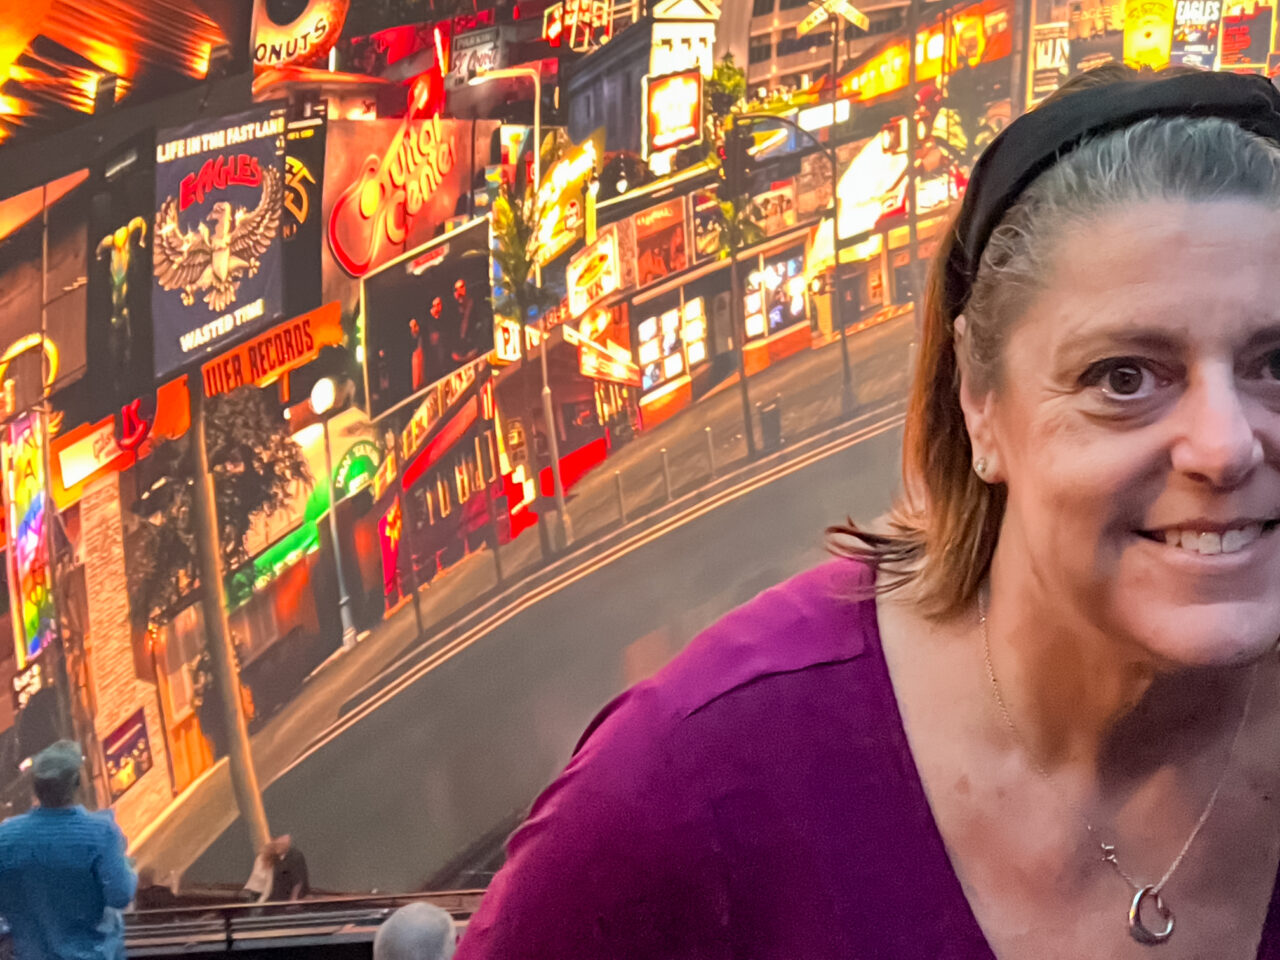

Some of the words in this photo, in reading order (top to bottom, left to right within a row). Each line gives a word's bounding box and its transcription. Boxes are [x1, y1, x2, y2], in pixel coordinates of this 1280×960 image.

[1176, 0, 1221, 21] EAGLES
[255, 17, 327, 63] ONUTS
[156, 138, 185, 164] LIFE
[186, 136, 201, 154] IN
[202, 129, 225, 153] THE
[227, 125, 255, 146] FAST
[179, 153, 263, 212] EAGLES
[179, 313, 234, 353] WASTED
[247, 318, 315, 382] RECORDS
